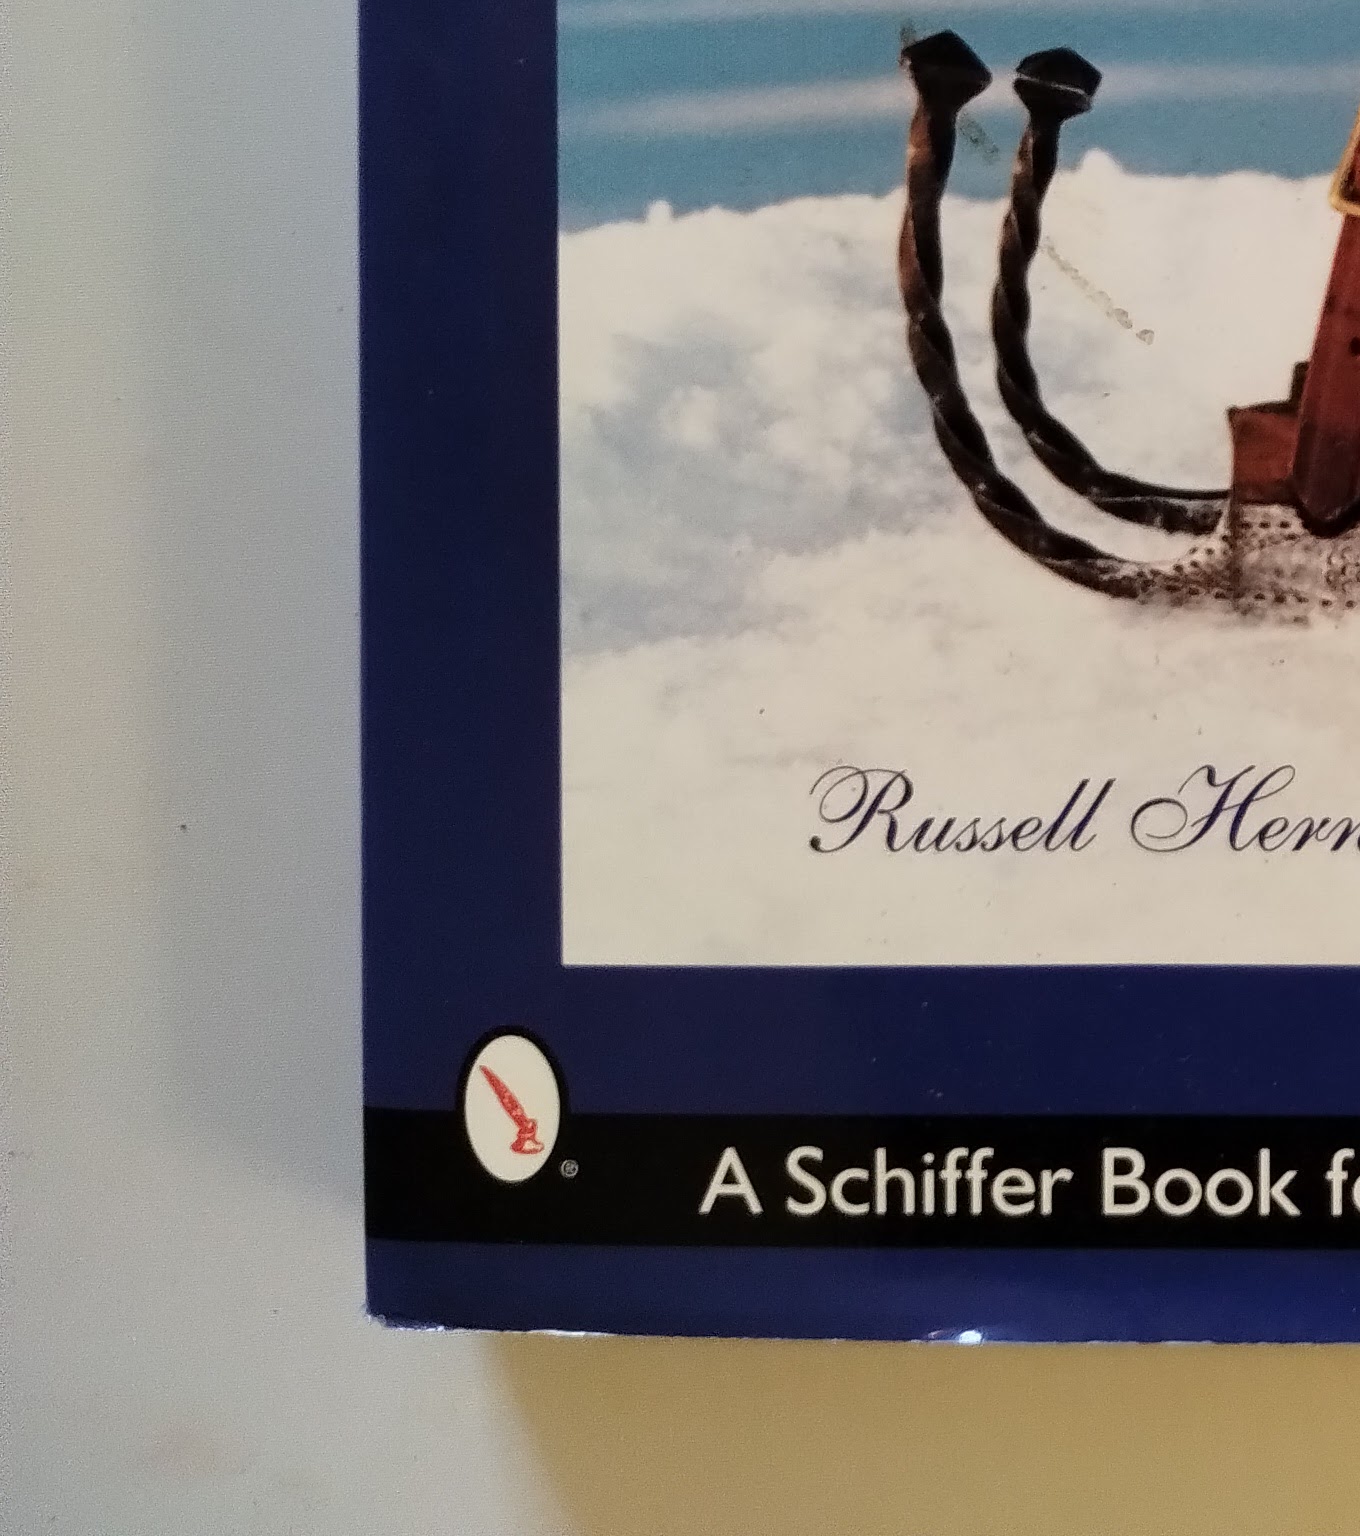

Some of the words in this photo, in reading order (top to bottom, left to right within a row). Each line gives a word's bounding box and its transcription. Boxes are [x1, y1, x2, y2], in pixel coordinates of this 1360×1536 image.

[809, 765, 1118, 854] Russell
[699, 1145, 764, 1216] A
[785, 1144, 1075, 1217] Schiffer
[1100, 1145, 1302, 1218] Book
